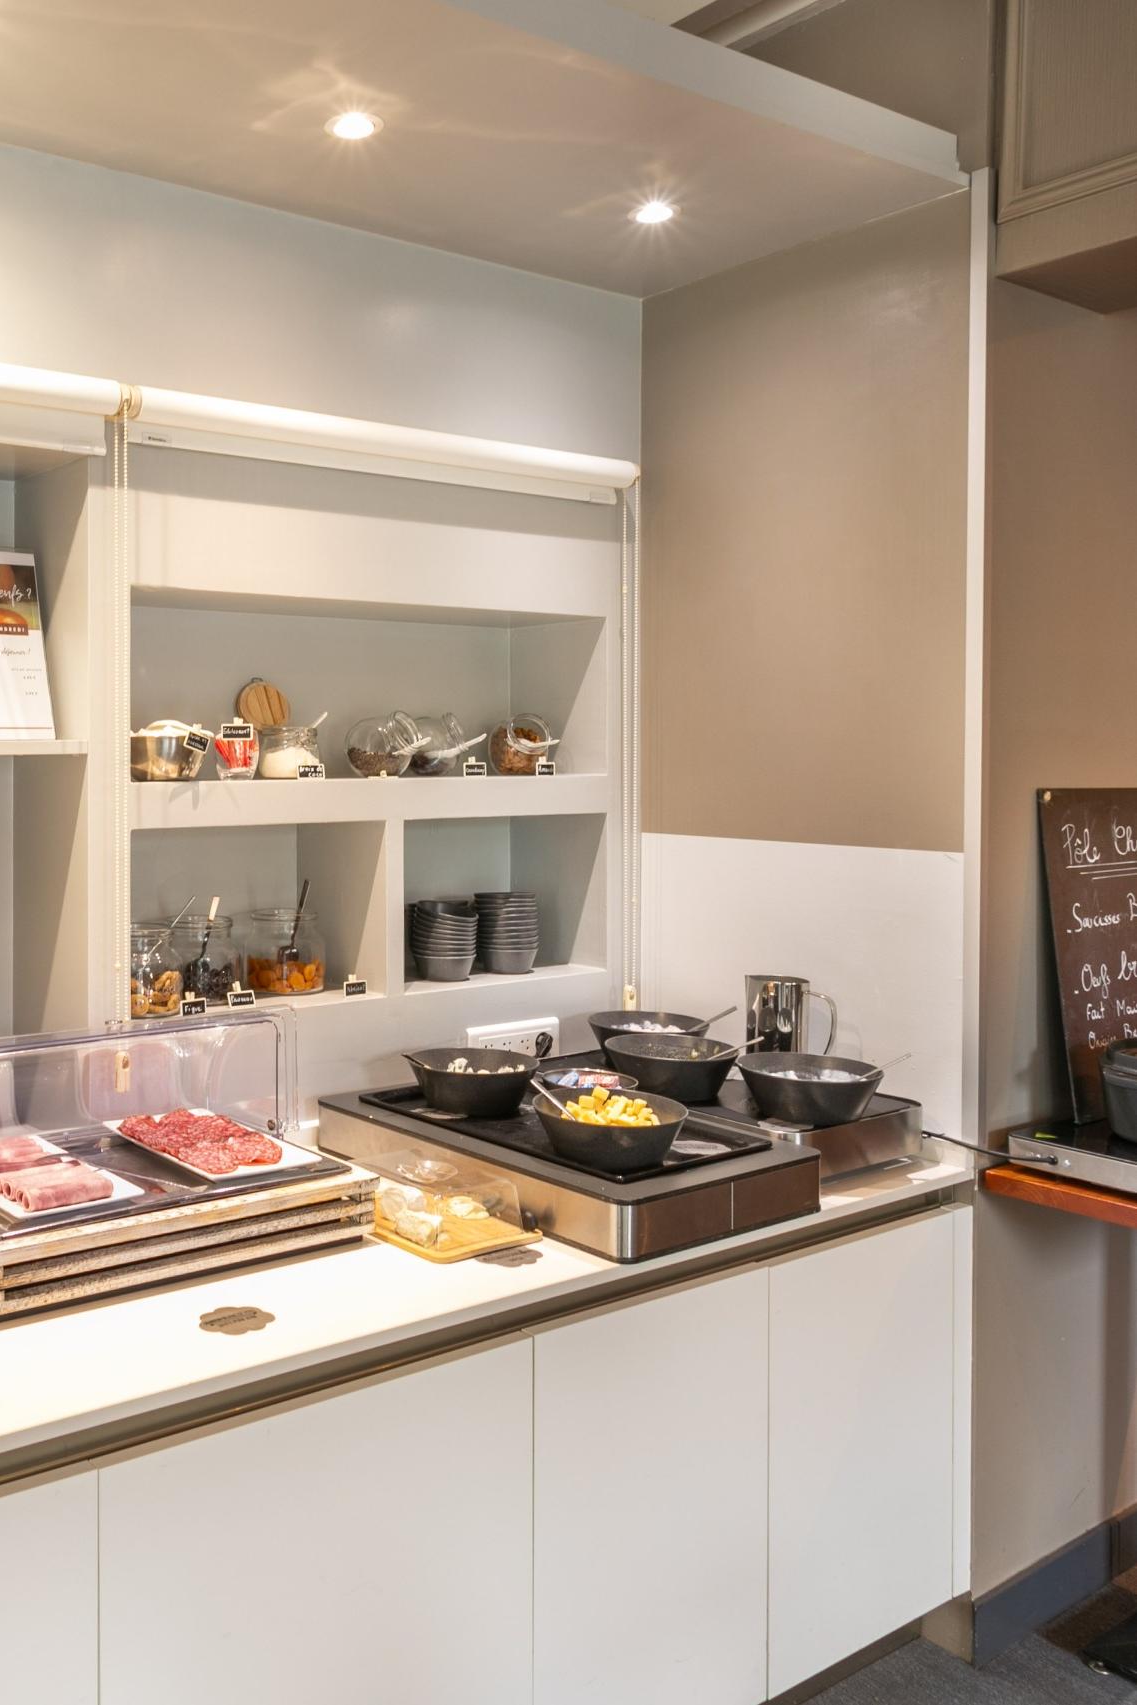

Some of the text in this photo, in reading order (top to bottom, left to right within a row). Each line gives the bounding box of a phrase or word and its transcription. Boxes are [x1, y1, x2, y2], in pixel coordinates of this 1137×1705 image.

[1061, 818, 1137, 866] Pôle Ch
[1086, 1001, 1106, 1021] Fait
